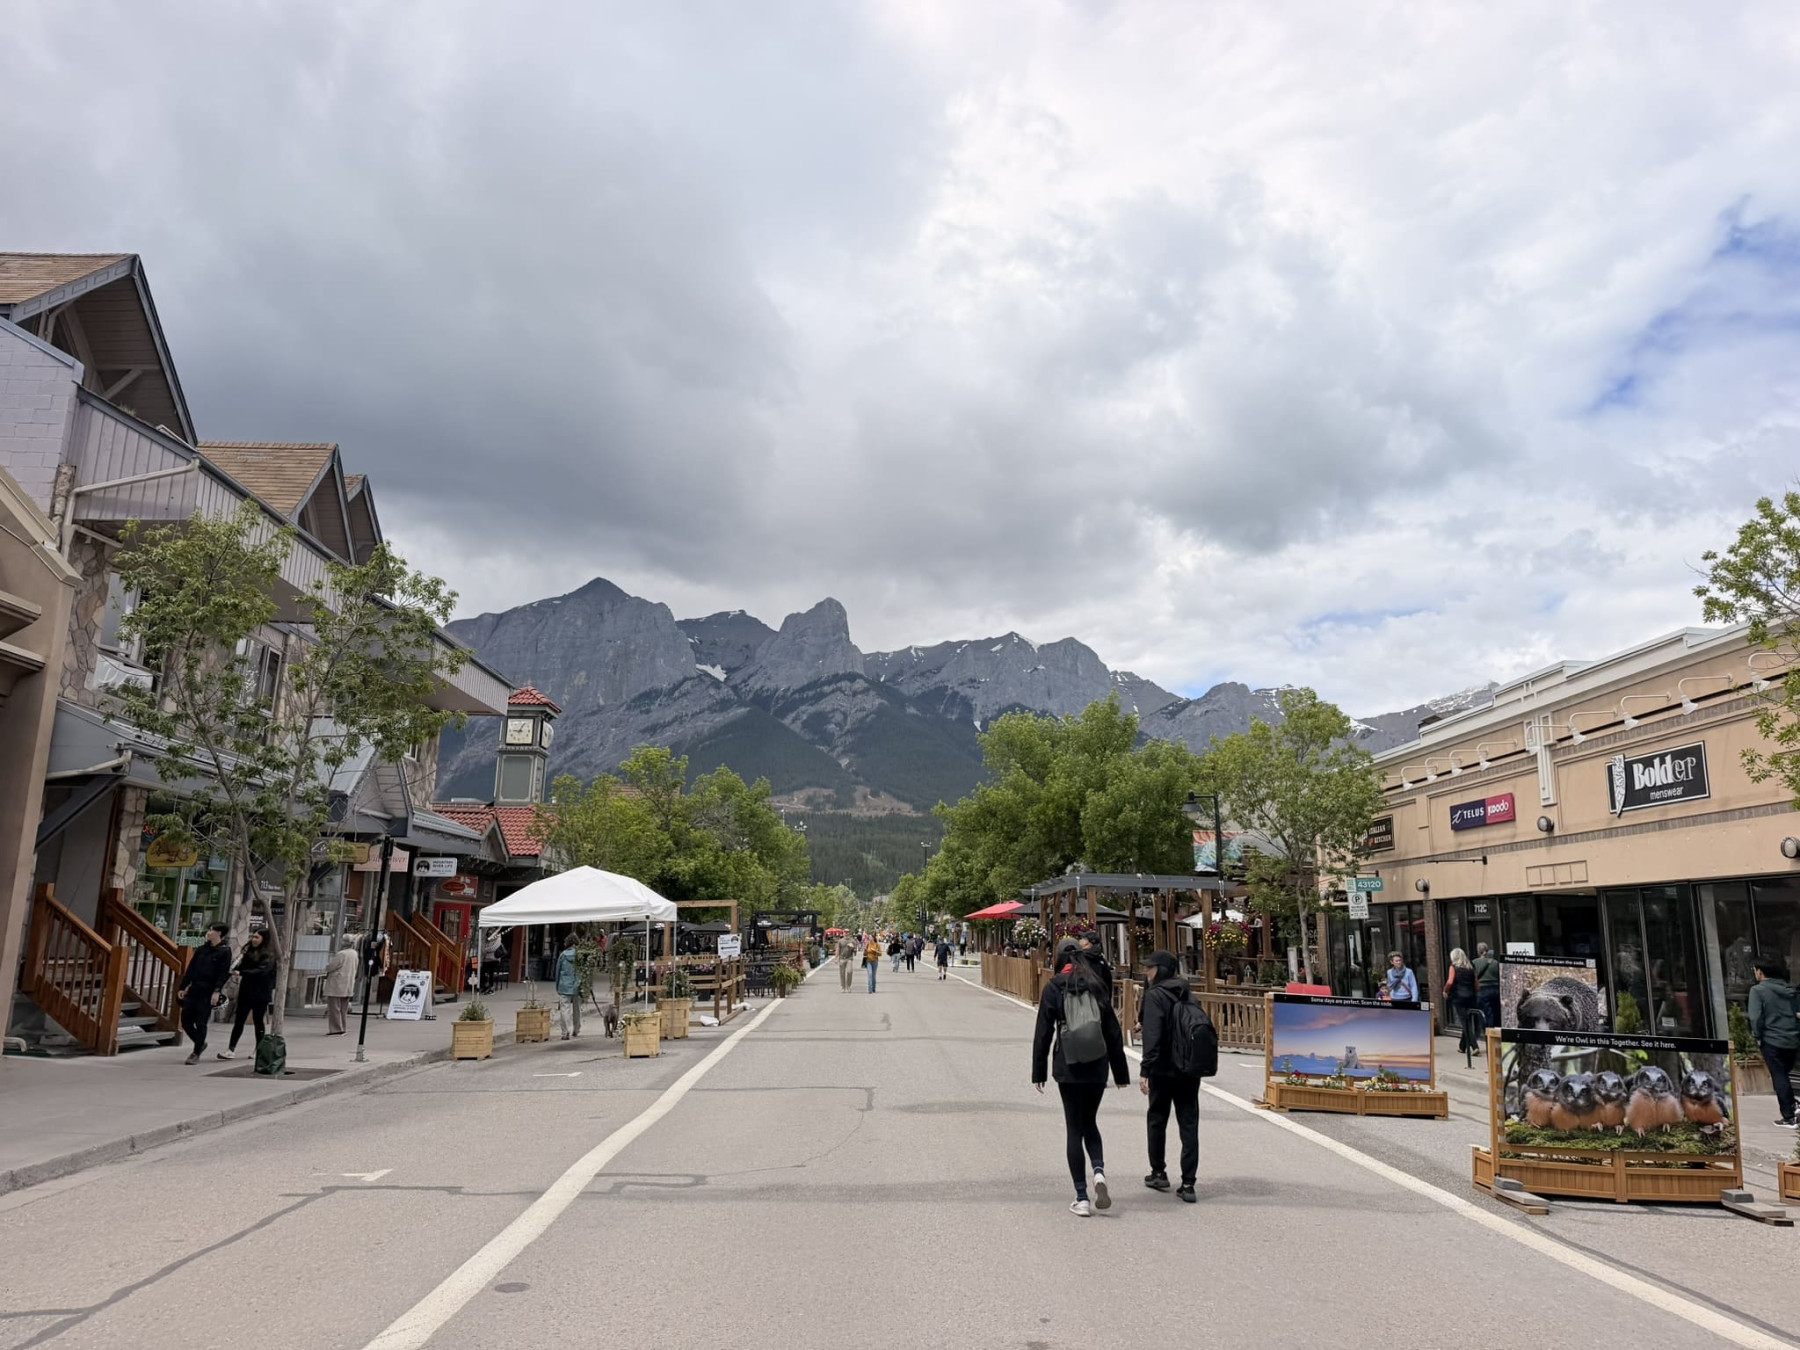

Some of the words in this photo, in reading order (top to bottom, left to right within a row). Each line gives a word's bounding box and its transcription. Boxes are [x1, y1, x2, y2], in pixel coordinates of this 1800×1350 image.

[1632, 753, 1697, 791] Bolder
[1649, 785, 1684, 800] menswear
[1463, 806, 1485, 819] TELUS
[1487, 799, 1509, 816] koodo
[1374, 835, 1392, 844] KITCHEN
[1474, 904, 1487, 913] 712C
[1611, 1038, 1640, 1047] Together.
